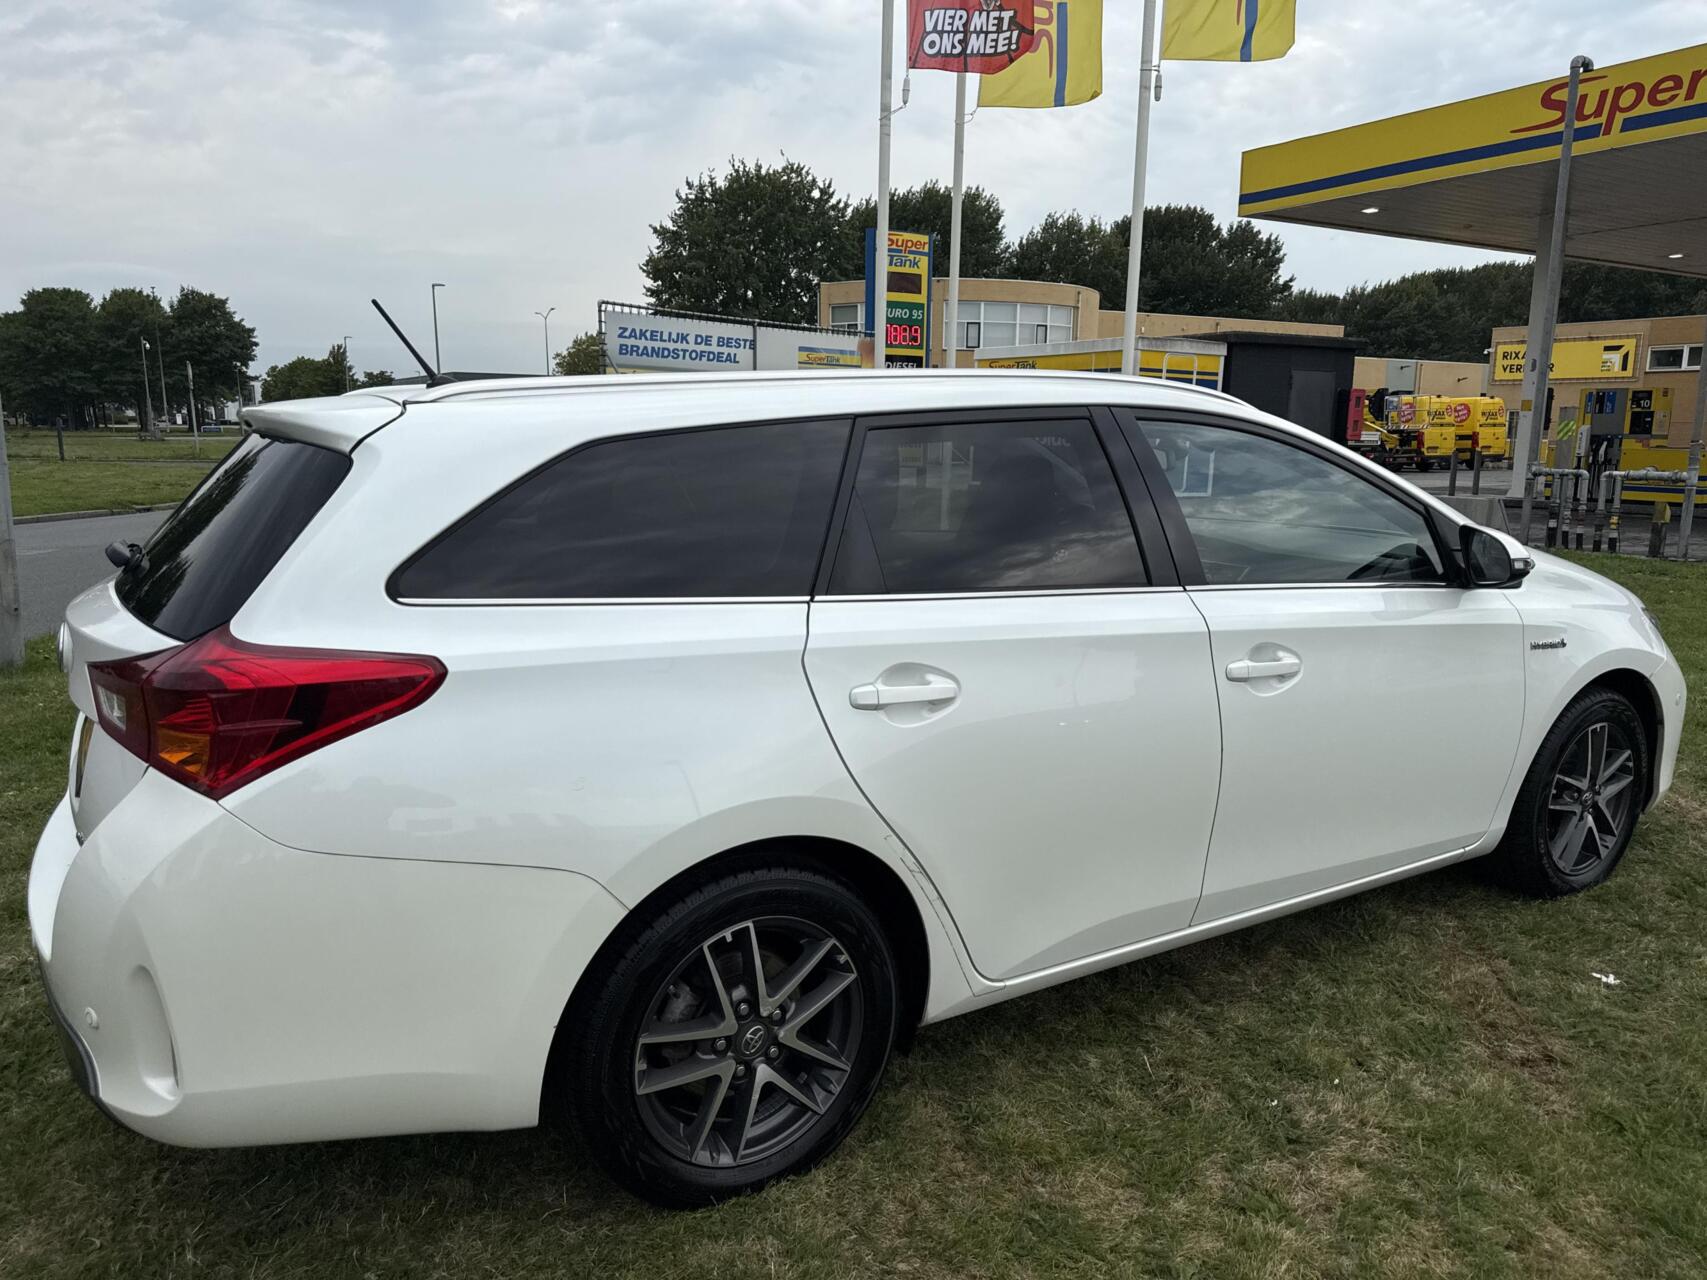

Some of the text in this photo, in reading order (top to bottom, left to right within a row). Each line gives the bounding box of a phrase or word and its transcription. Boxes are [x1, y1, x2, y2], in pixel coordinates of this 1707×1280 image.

[924, 9, 1014, 32] VIER MET
[923, 30, 1019, 55] ONS MEE!
[1509, 68, 1707, 136] Super
[887, 233, 928, 254] Super
[888, 254, 921, 269] Tank
[887, 308, 923, 320] URO 95
[617, 326, 756, 350] ZAKELIJK DE BESTE
[618, 343, 740, 364] BRANDSTOFDEAL
[1639, 399, 1650, 408] 10
